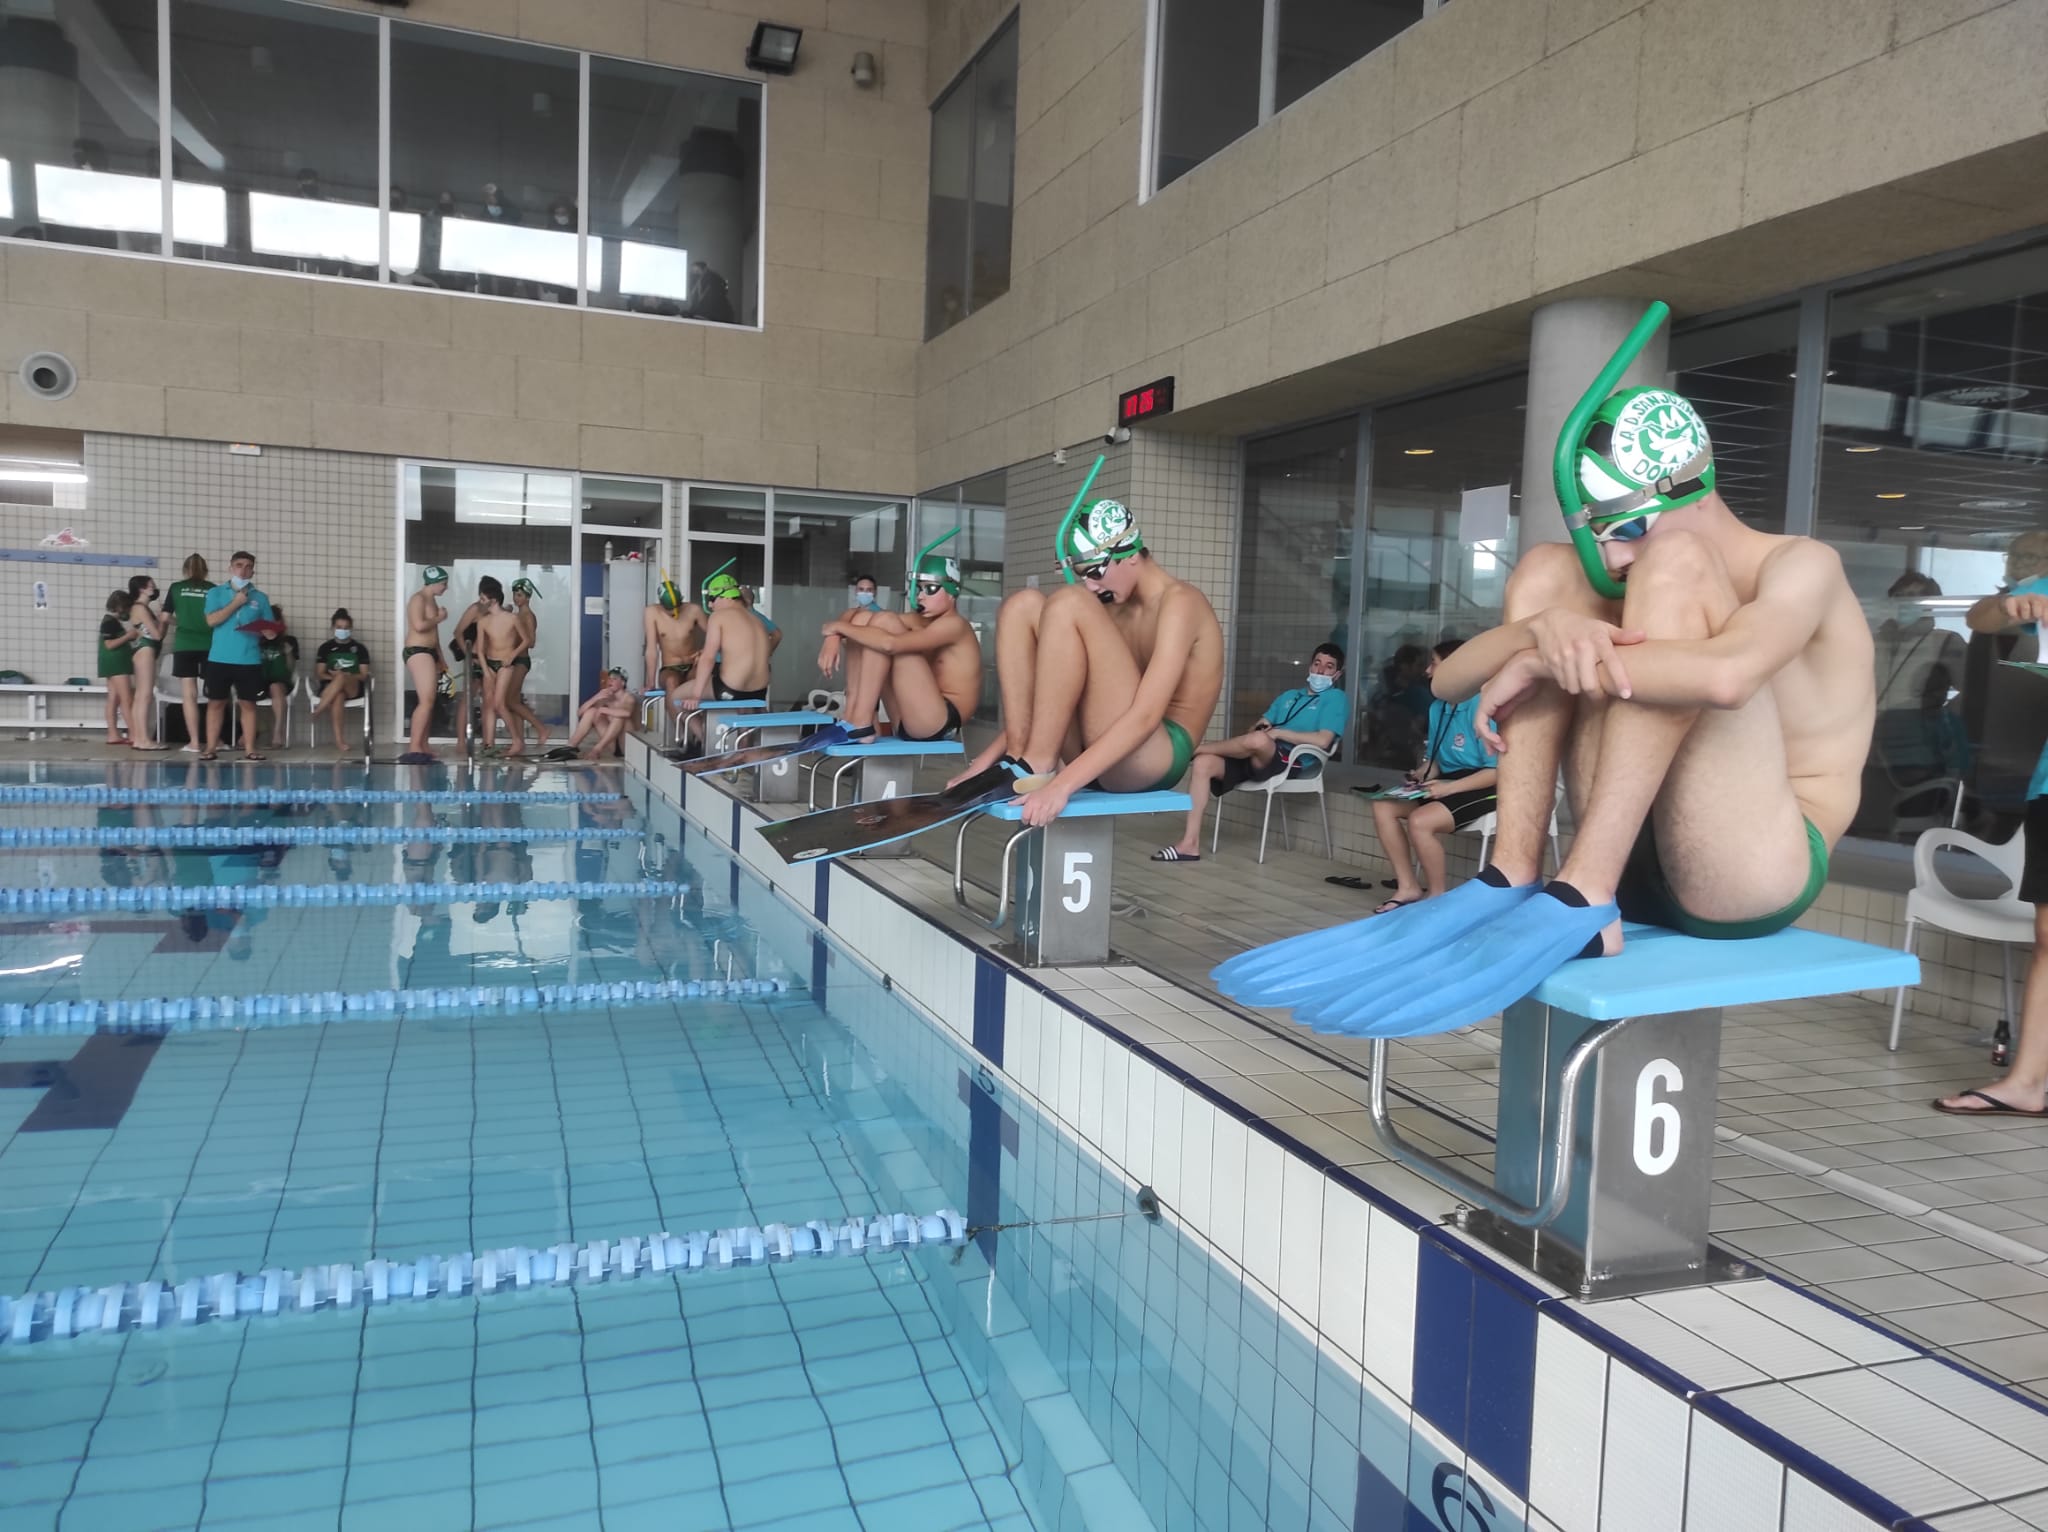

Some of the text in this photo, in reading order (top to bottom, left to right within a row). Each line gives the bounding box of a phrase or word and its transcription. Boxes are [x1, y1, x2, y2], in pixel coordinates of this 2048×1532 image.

[1632, 395, 1661, 416] SAN
[1660, 393, 1695, 417] JUAN
[715, 723, 730, 750] 2
[1062, 852, 1093, 913] 5
[978, 1063, 995, 1095] 5
[1633, 1058, 1683, 1176] 6
[1431, 1462, 1497, 1532] 6
